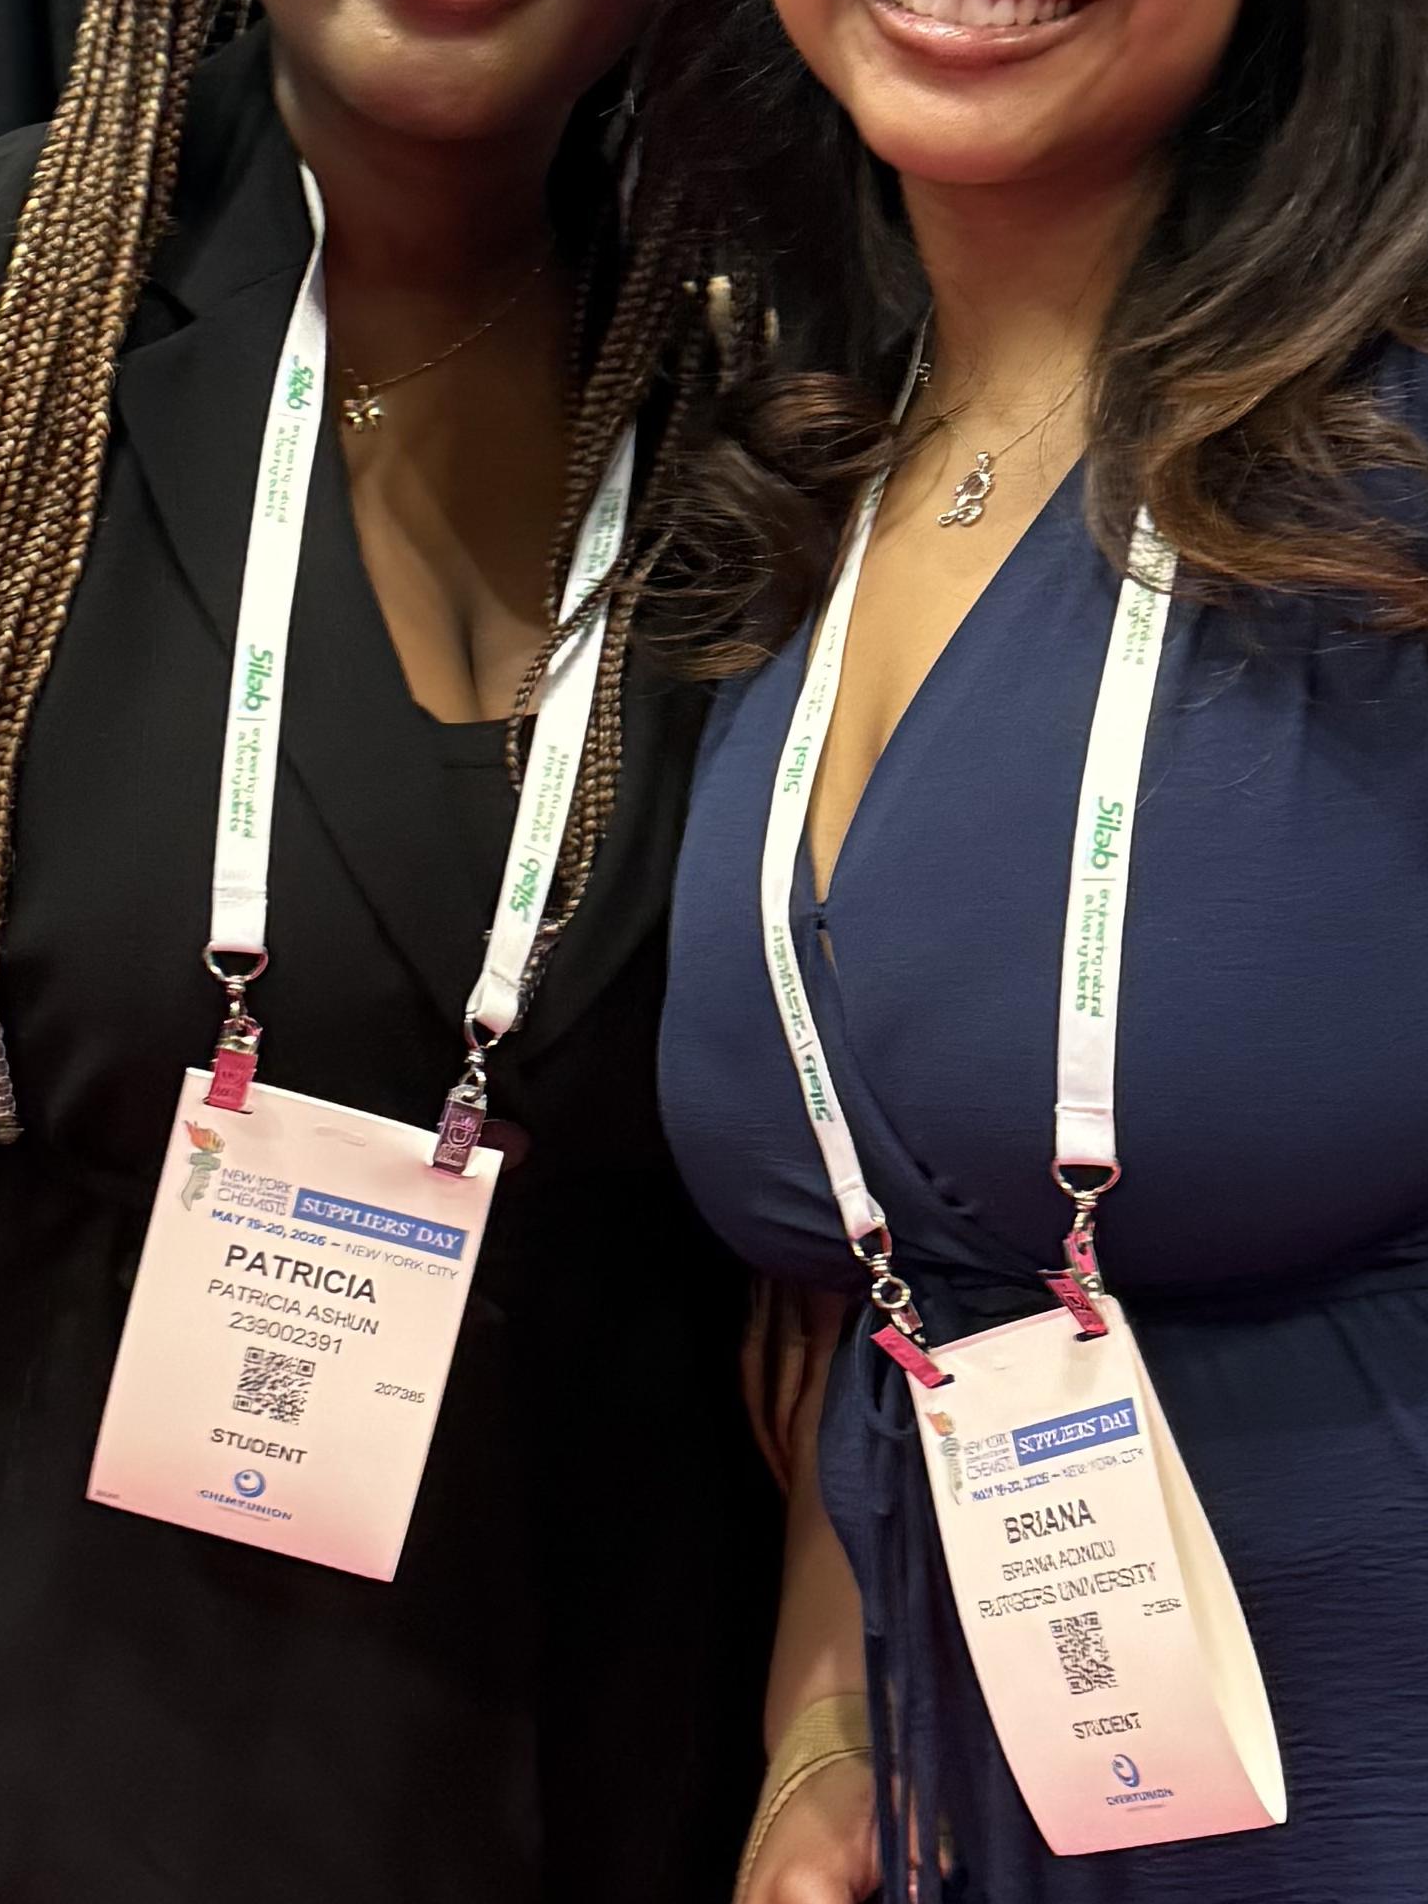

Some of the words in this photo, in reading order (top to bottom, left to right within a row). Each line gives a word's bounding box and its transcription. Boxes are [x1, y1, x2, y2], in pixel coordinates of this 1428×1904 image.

[288, 354, 314, 411] Silab
[243, 643, 274, 712] Silab
[1089, 795, 1125, 871] Silab
[299, 1196, 415, 1239] SUPPLIERS'
[415, 1226, 461, 1251] DAY
[223, 1243, 377, 1305] PATRICIA
[343, 1241, 381, 1261] NEW
[383, 1251, 424, 1271] YORK
[426, 1262, 460, 1281] CITY
[206, 1278, 302, 1317] PATRICIA
[305, 1306, 381, 1336] ASHUN
[228, 1310, 344, 1356] 239002391
[210, 1426, 309, 1466] STUDENT
[1002, 1497, 1097, 1545] BRIANA
